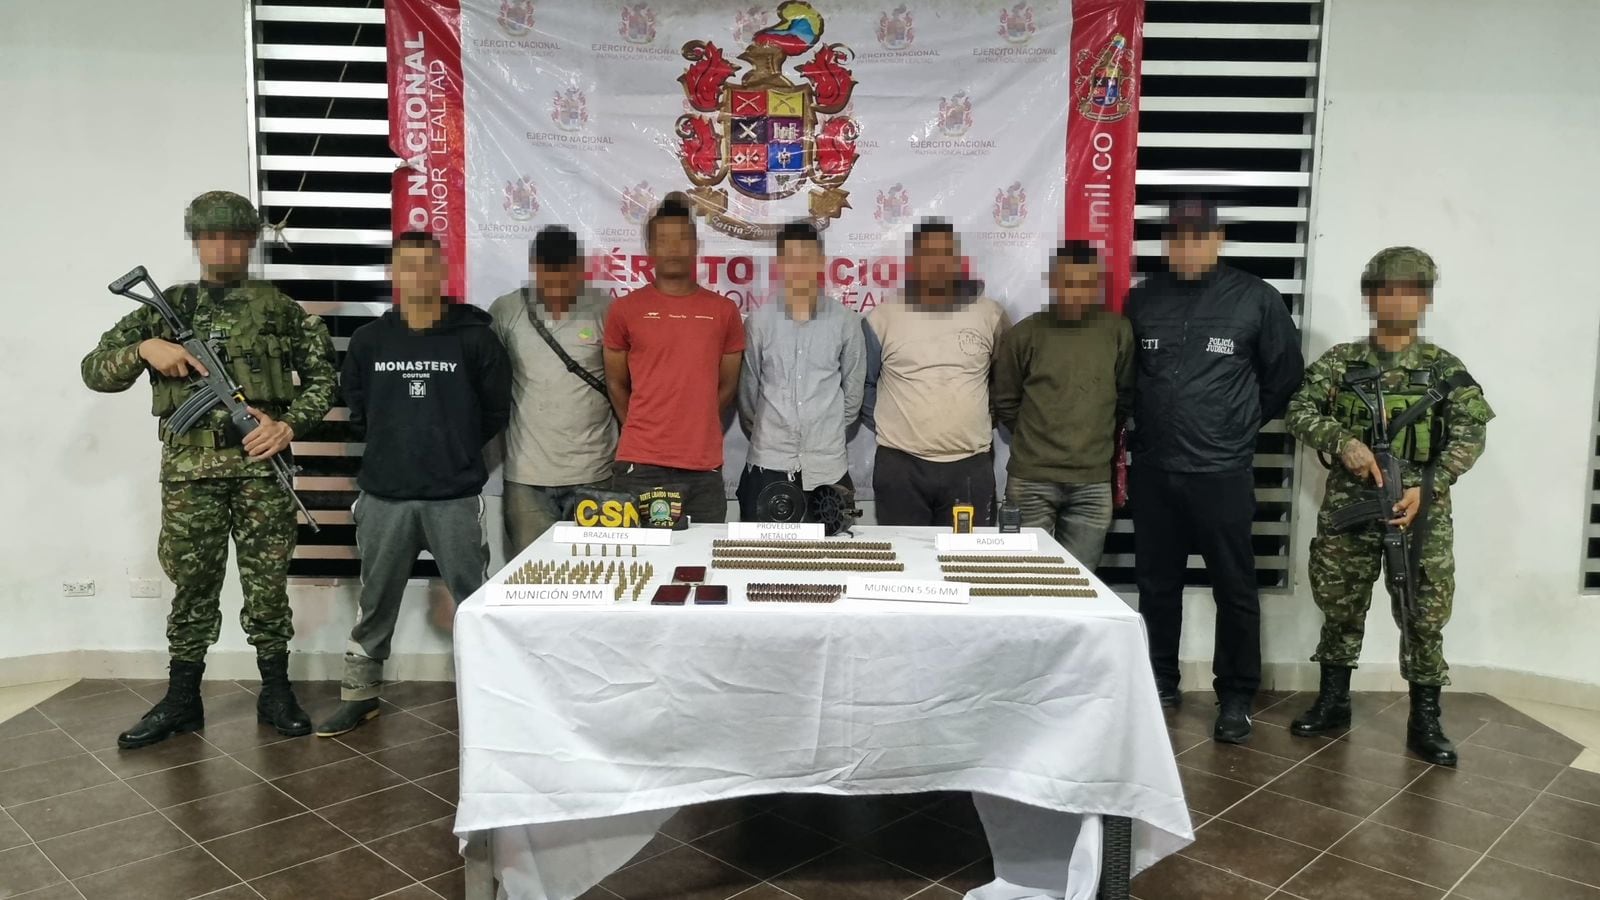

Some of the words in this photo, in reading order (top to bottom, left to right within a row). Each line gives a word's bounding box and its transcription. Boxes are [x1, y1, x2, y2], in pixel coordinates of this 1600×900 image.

[429, 59, 447, 154] LEALTAD
[404, 31, 428, 196] NACIONAL
[374, 361, 458, 373] MONASTERY
[576, 499, 640, 528] CSN
[583, 530, 629, 540] BRAZALETES
[976, 537, 1006, 546] RADIOS
[505, 587, 569, 600] MUNICIÓN
[571, 589, 604, 600] 9MM
[938, 587, 959, 596] MM
